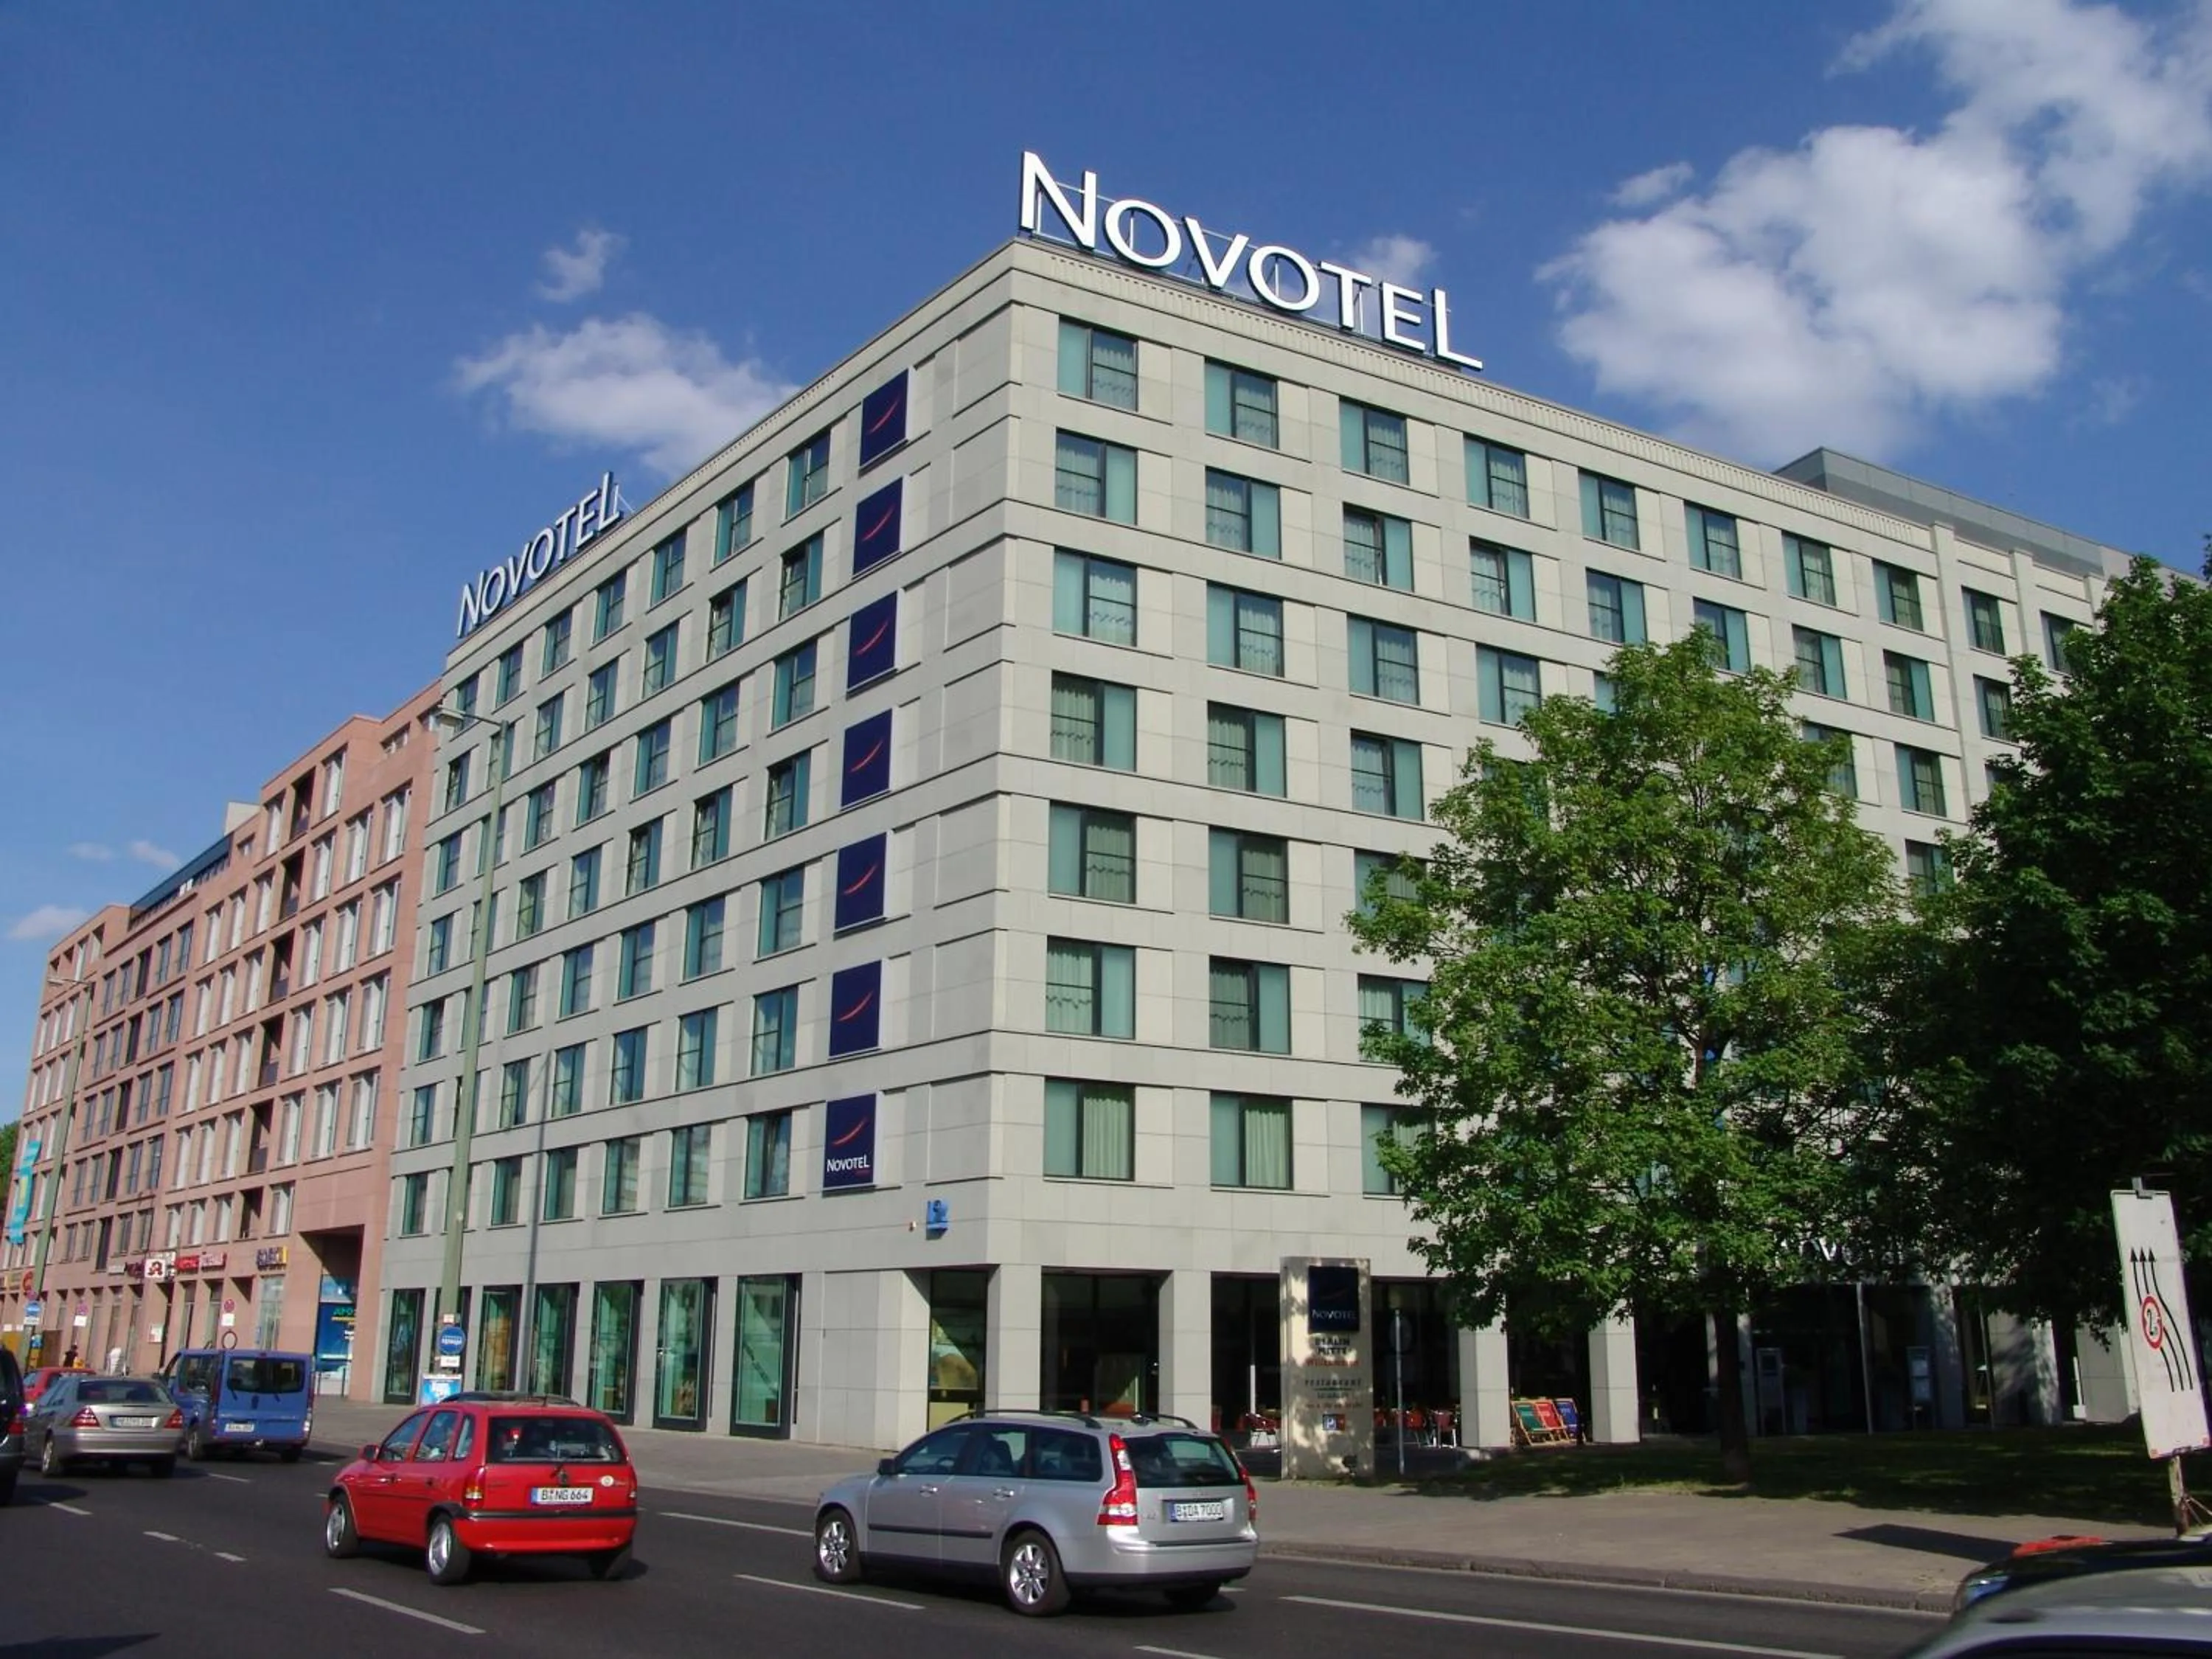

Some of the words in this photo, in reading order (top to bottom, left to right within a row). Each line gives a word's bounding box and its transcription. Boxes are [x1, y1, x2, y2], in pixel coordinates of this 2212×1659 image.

[1019, 150, 1484, 372] NOVOTEL
[456, 470, 622, 639] NOVOTEL
[827, 1155, 870, 1172] NOVOTEL
[1311, 1309, 1357, 1319] NOVOTEL
[570, 1489, 588, 1500] 664
